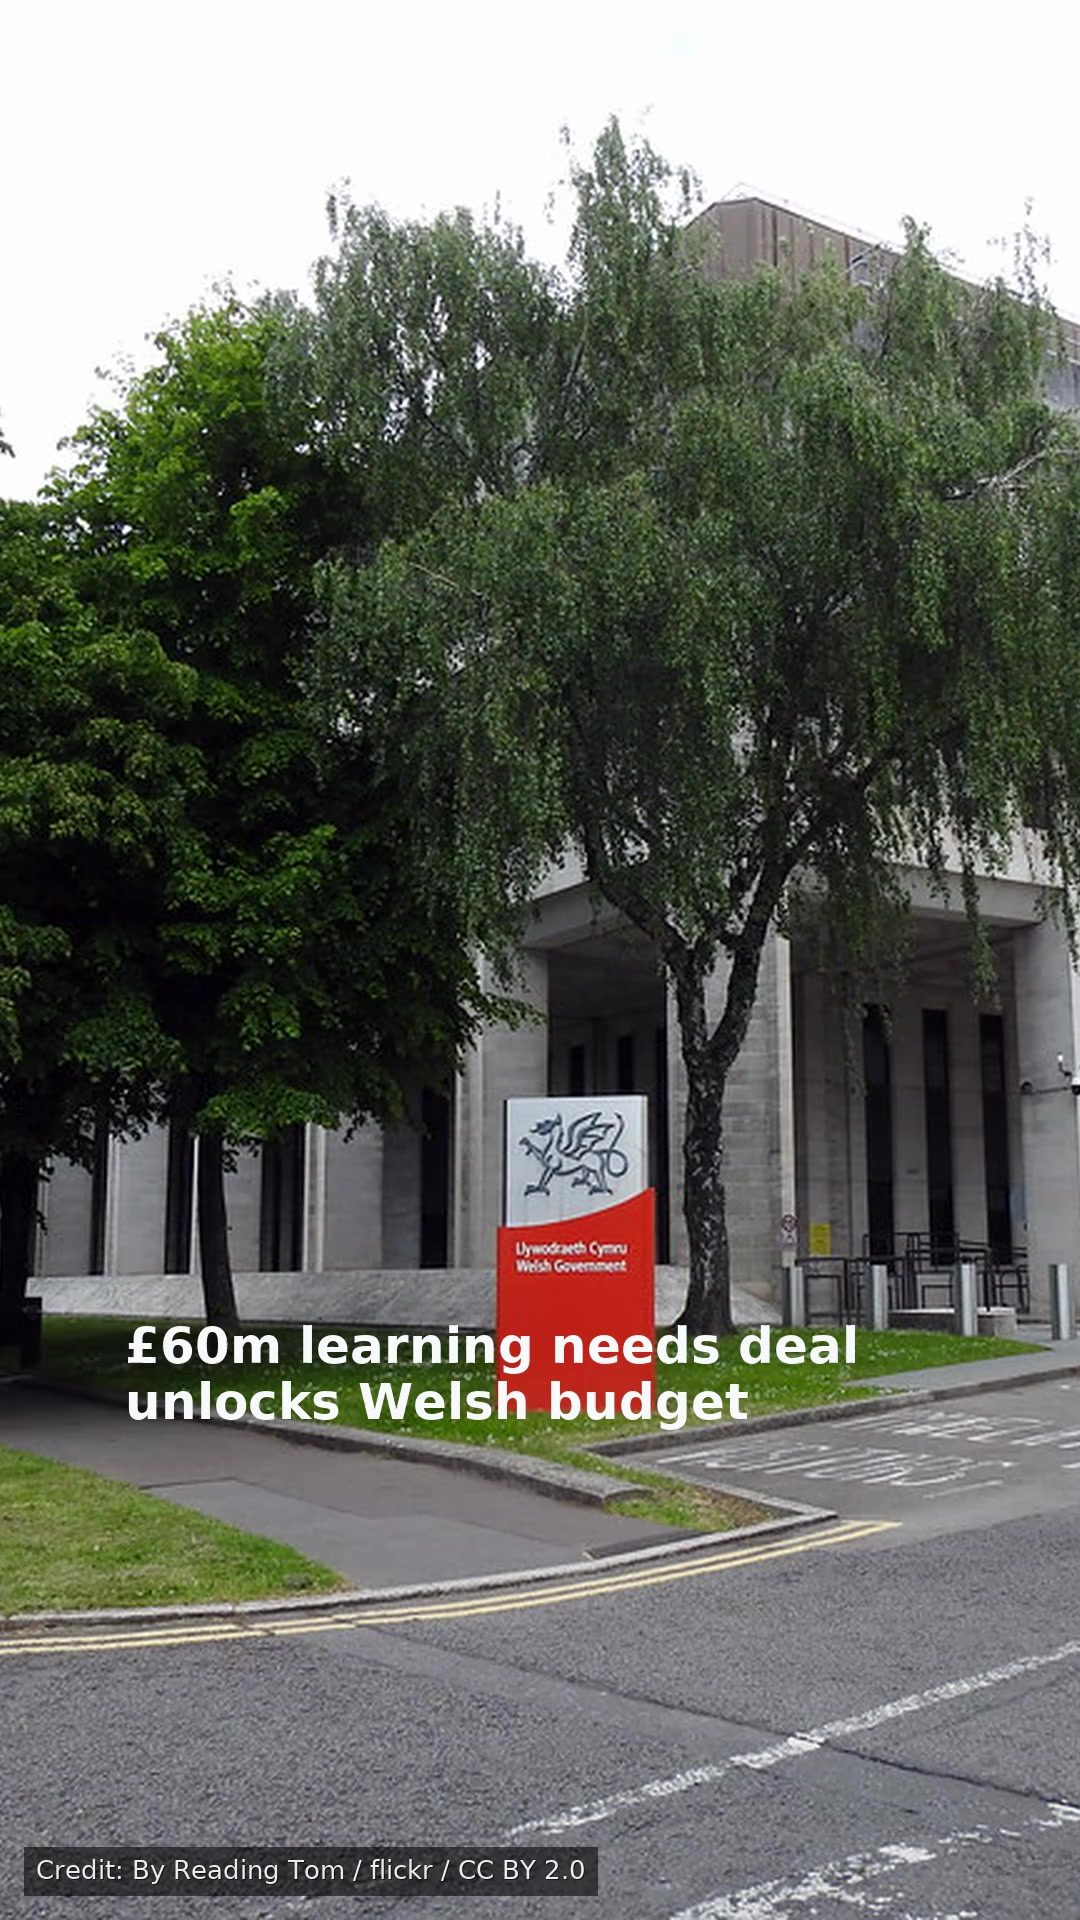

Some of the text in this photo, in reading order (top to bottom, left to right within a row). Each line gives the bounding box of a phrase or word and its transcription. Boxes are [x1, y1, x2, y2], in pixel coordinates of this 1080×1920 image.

[516, 1241, 628, 1258] Llywodraeth Cymru
[516, 1257, 628, 1273] Welsh Government
